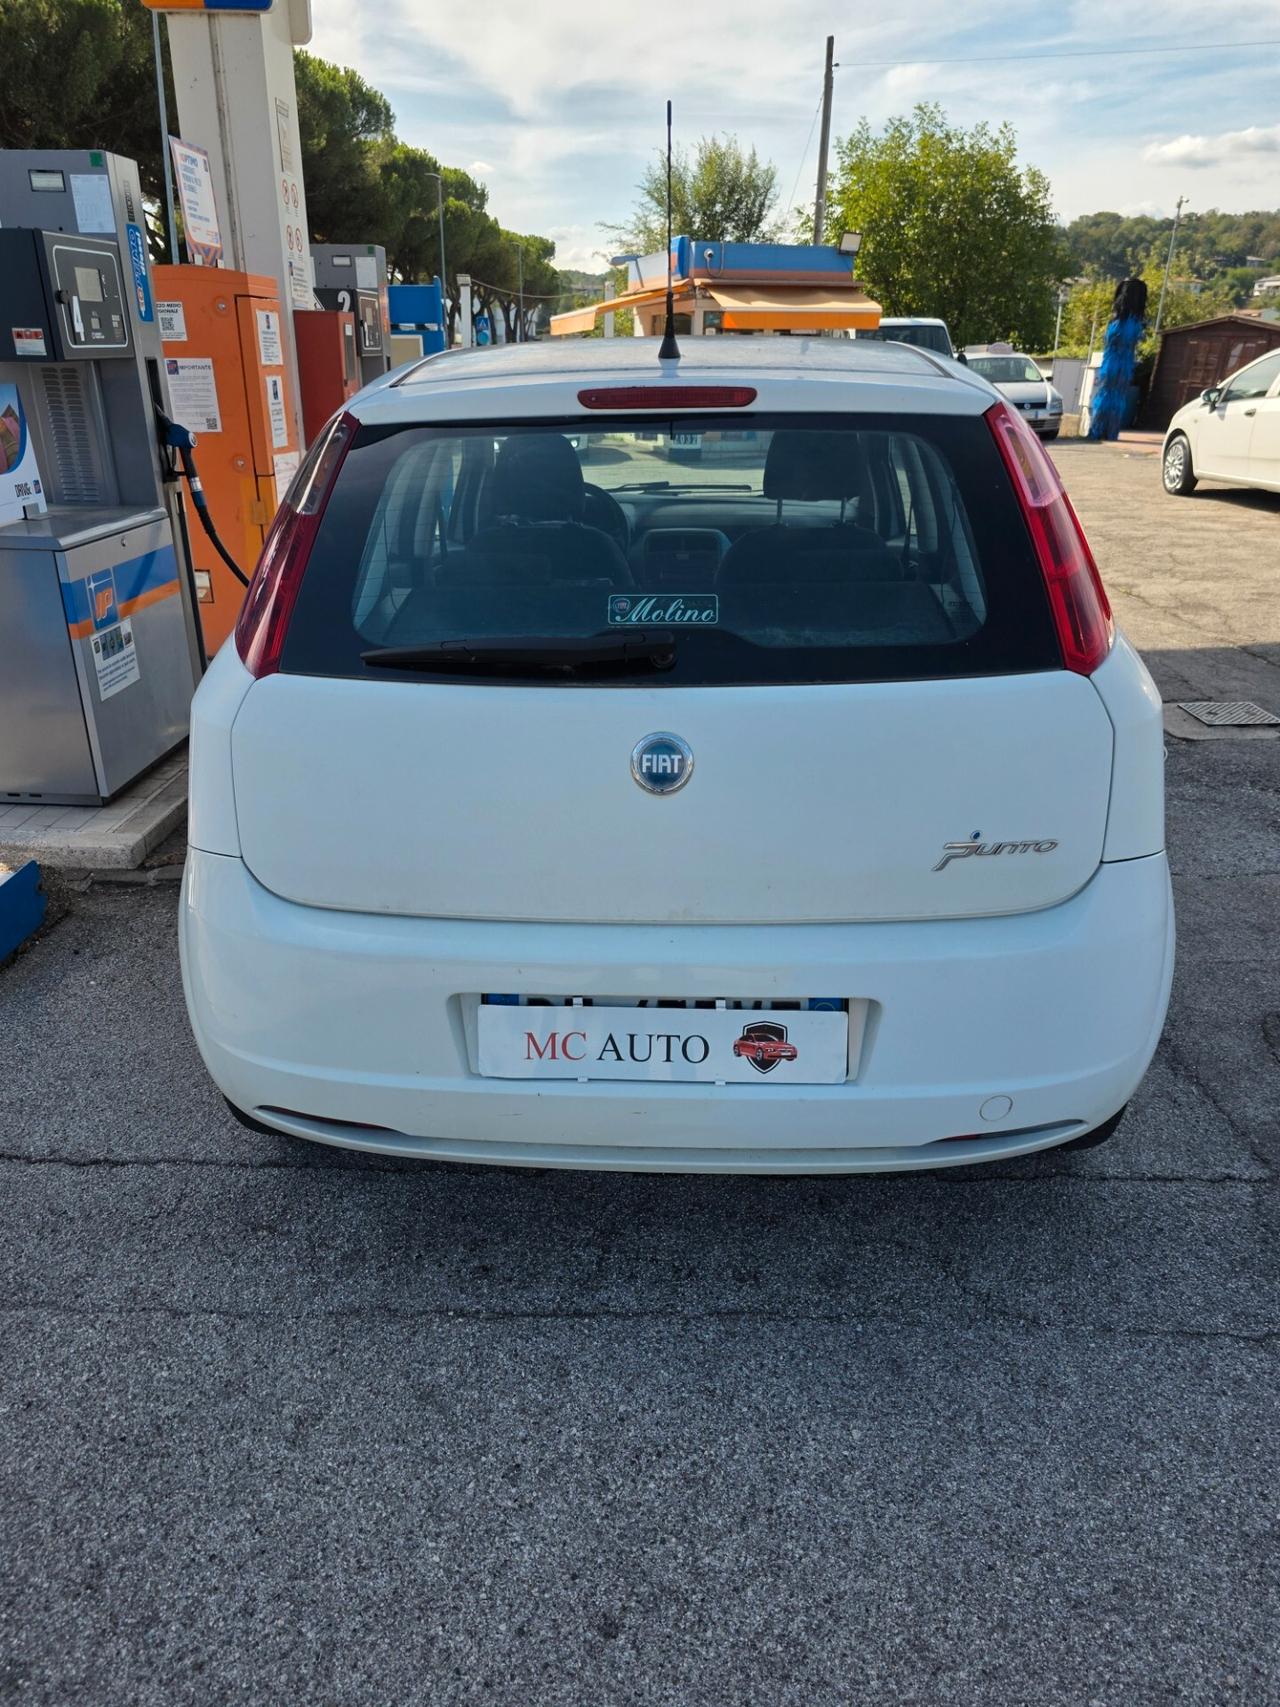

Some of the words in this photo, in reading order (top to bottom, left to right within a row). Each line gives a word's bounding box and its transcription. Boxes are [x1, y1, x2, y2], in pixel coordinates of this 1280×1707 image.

[615, 597, 714, 622] Molino
[642, 754, 682, 773] FIAT
[523, 1031, 588, 1061] MC
[596, 1033, 711, 1064] AUTO
